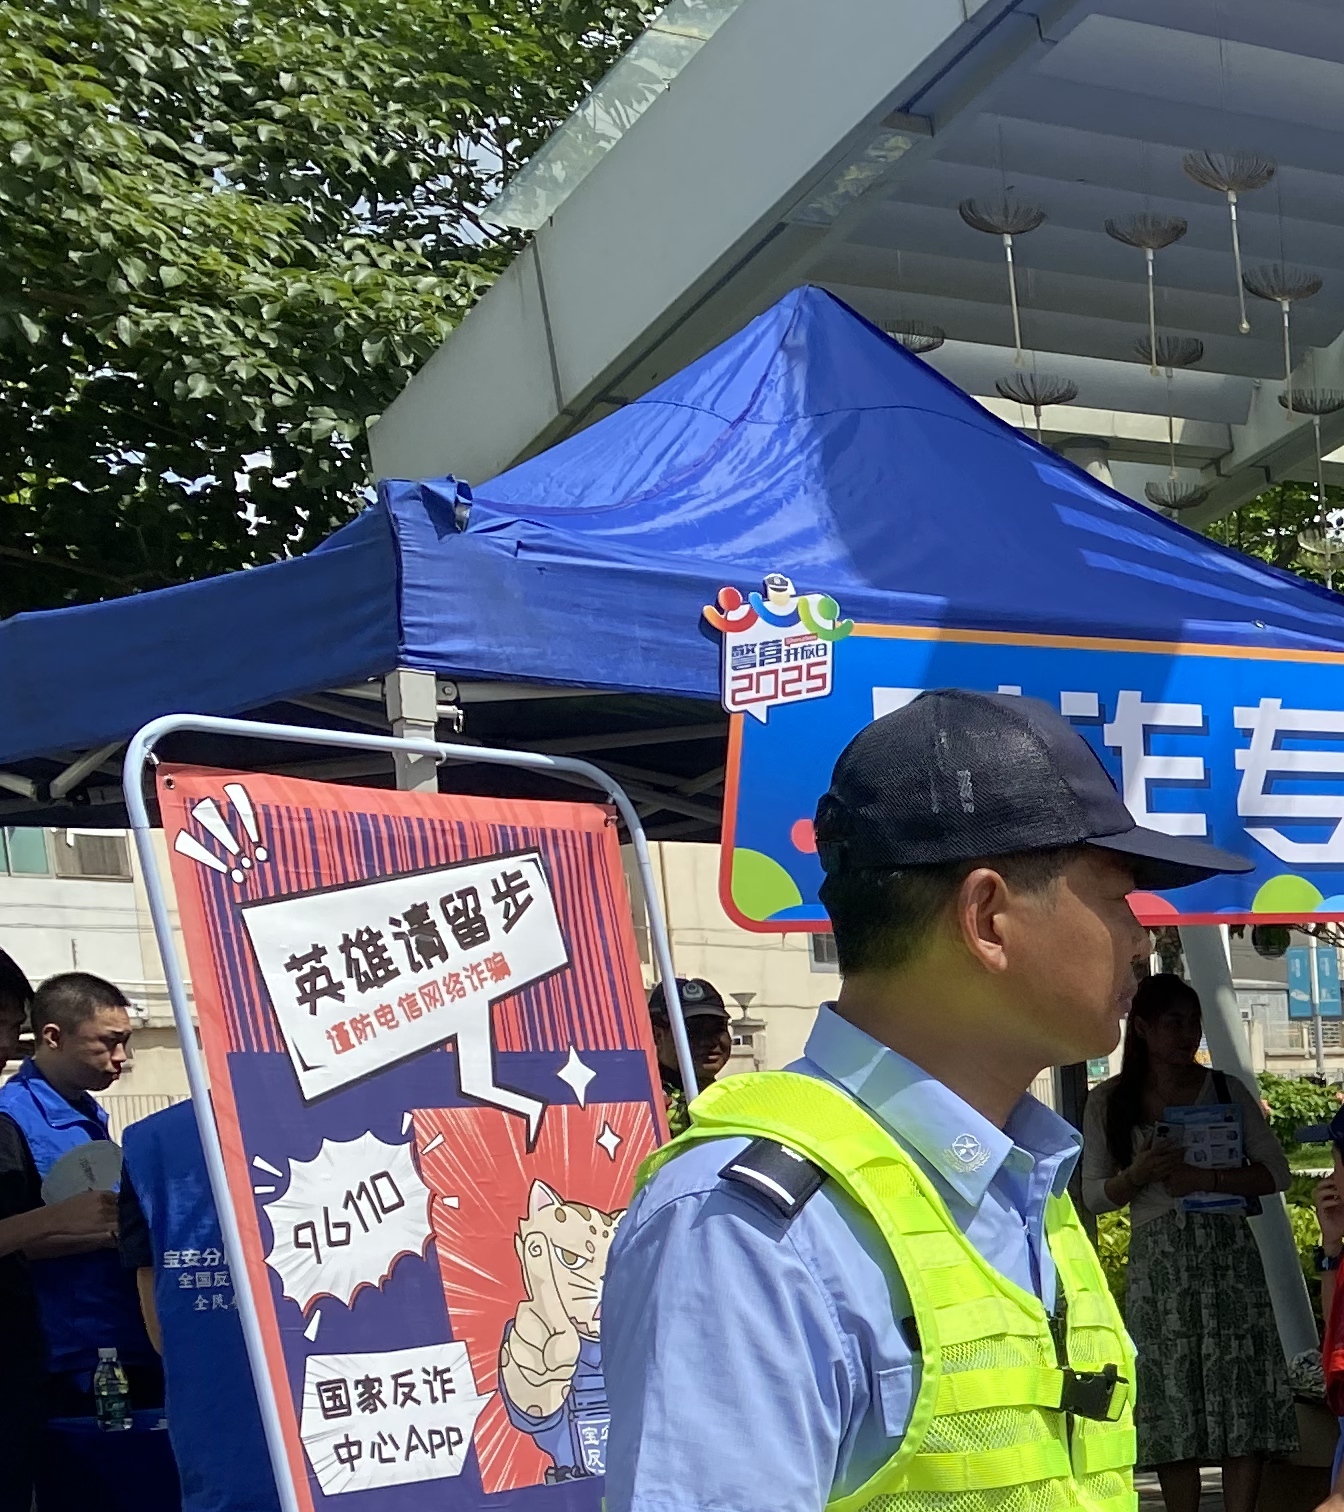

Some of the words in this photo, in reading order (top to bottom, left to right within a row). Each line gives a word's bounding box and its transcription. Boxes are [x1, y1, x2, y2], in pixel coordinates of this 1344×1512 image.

[731, 660, 828, 706] 2025
[283, 869, 534, 1016] 英雄请留步
[325, 951, 512, 1055] 谨防电信网络诈骗
[293, 1170, 406, 1264] 96110
[163, 1247, 228, 1269] 宝安分
[316, 1366, 457, 1419] 国家反诈
[333, 1424, 464, 1473] 中心App
